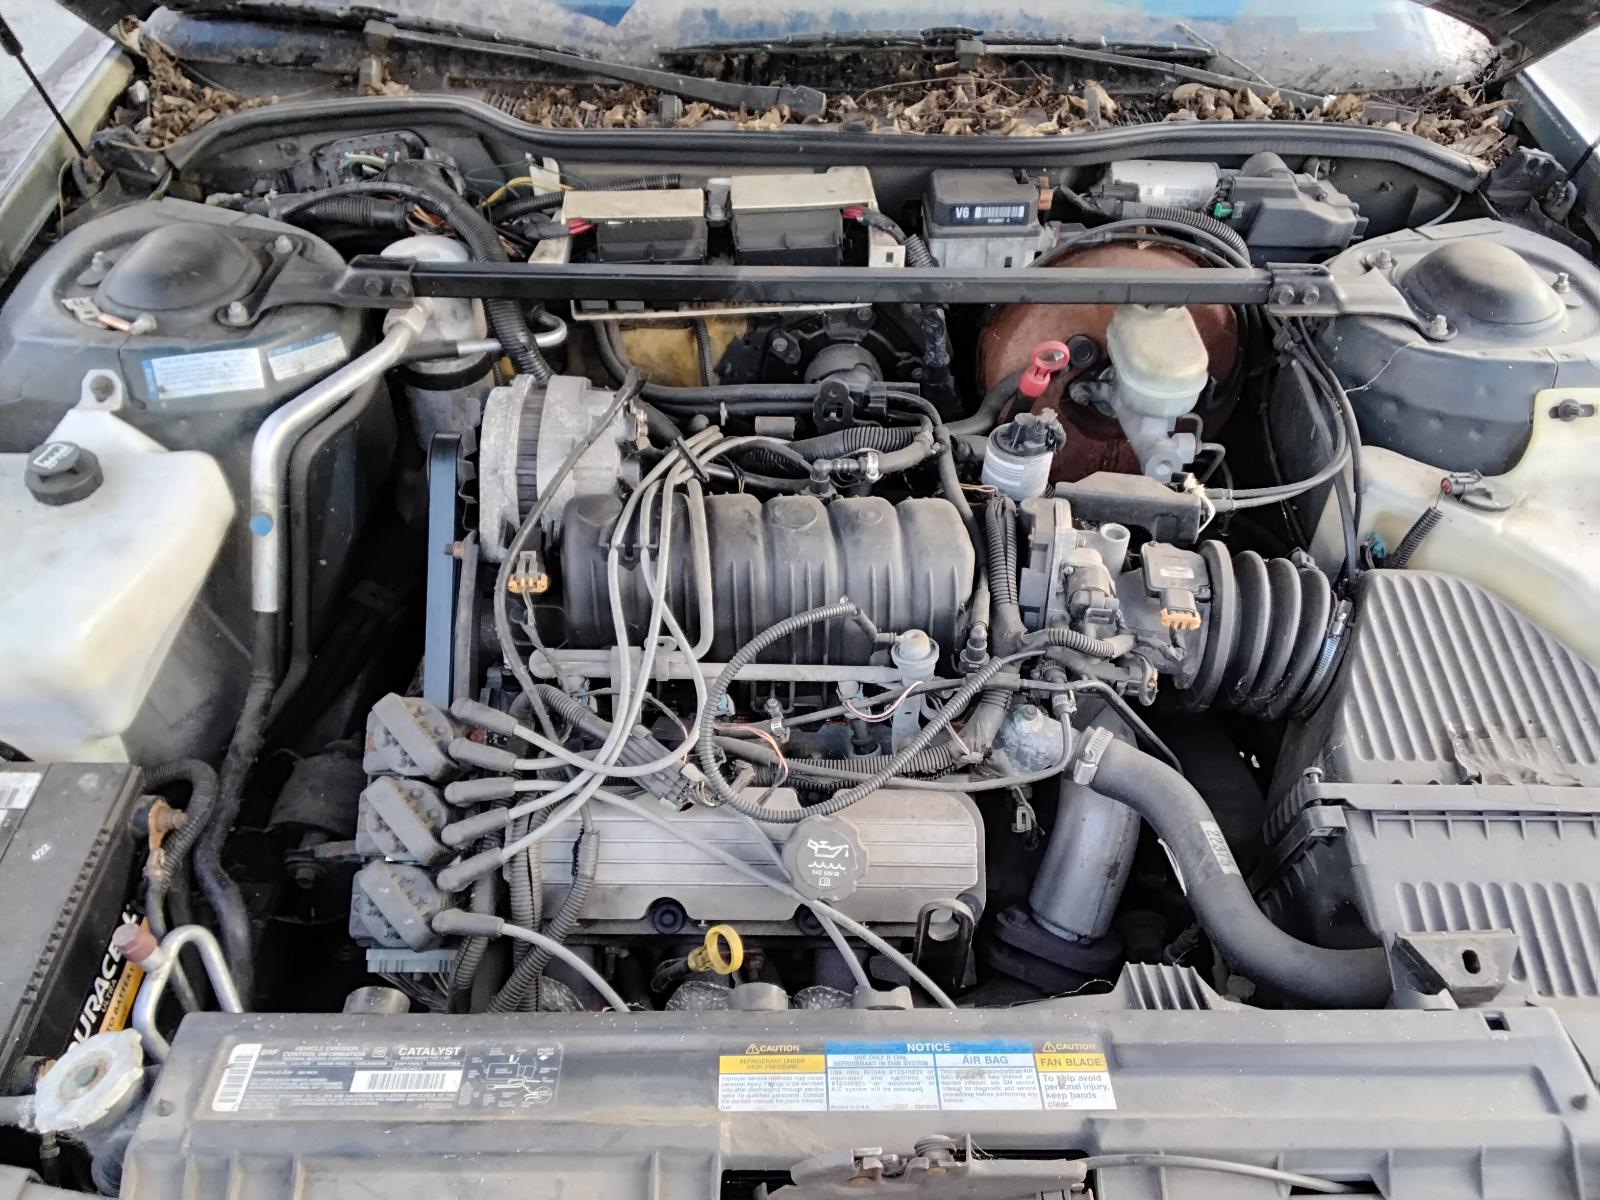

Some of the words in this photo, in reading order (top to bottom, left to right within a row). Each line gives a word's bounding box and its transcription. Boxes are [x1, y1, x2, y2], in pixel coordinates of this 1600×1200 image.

[955, 206, 970, 219] V6
[398, 1046, 462, 1056] CATALYST
[907, 1043, 951, 1051] NOTICE
[962, 1055, 981, 1064] AIR
[984, 1055, 1009, 1064] BAG
[1040, 1058, 1062, 1066] FAN
[1065, 1058, 1103, 1066] BLADE
[1056, 1074, 1075, 1083] help
[1044, 1083, 1081, 1091] personal
[1083, 1083, 1110, 1091] injury,
[1046, 1091, 1067, 1100] keep
